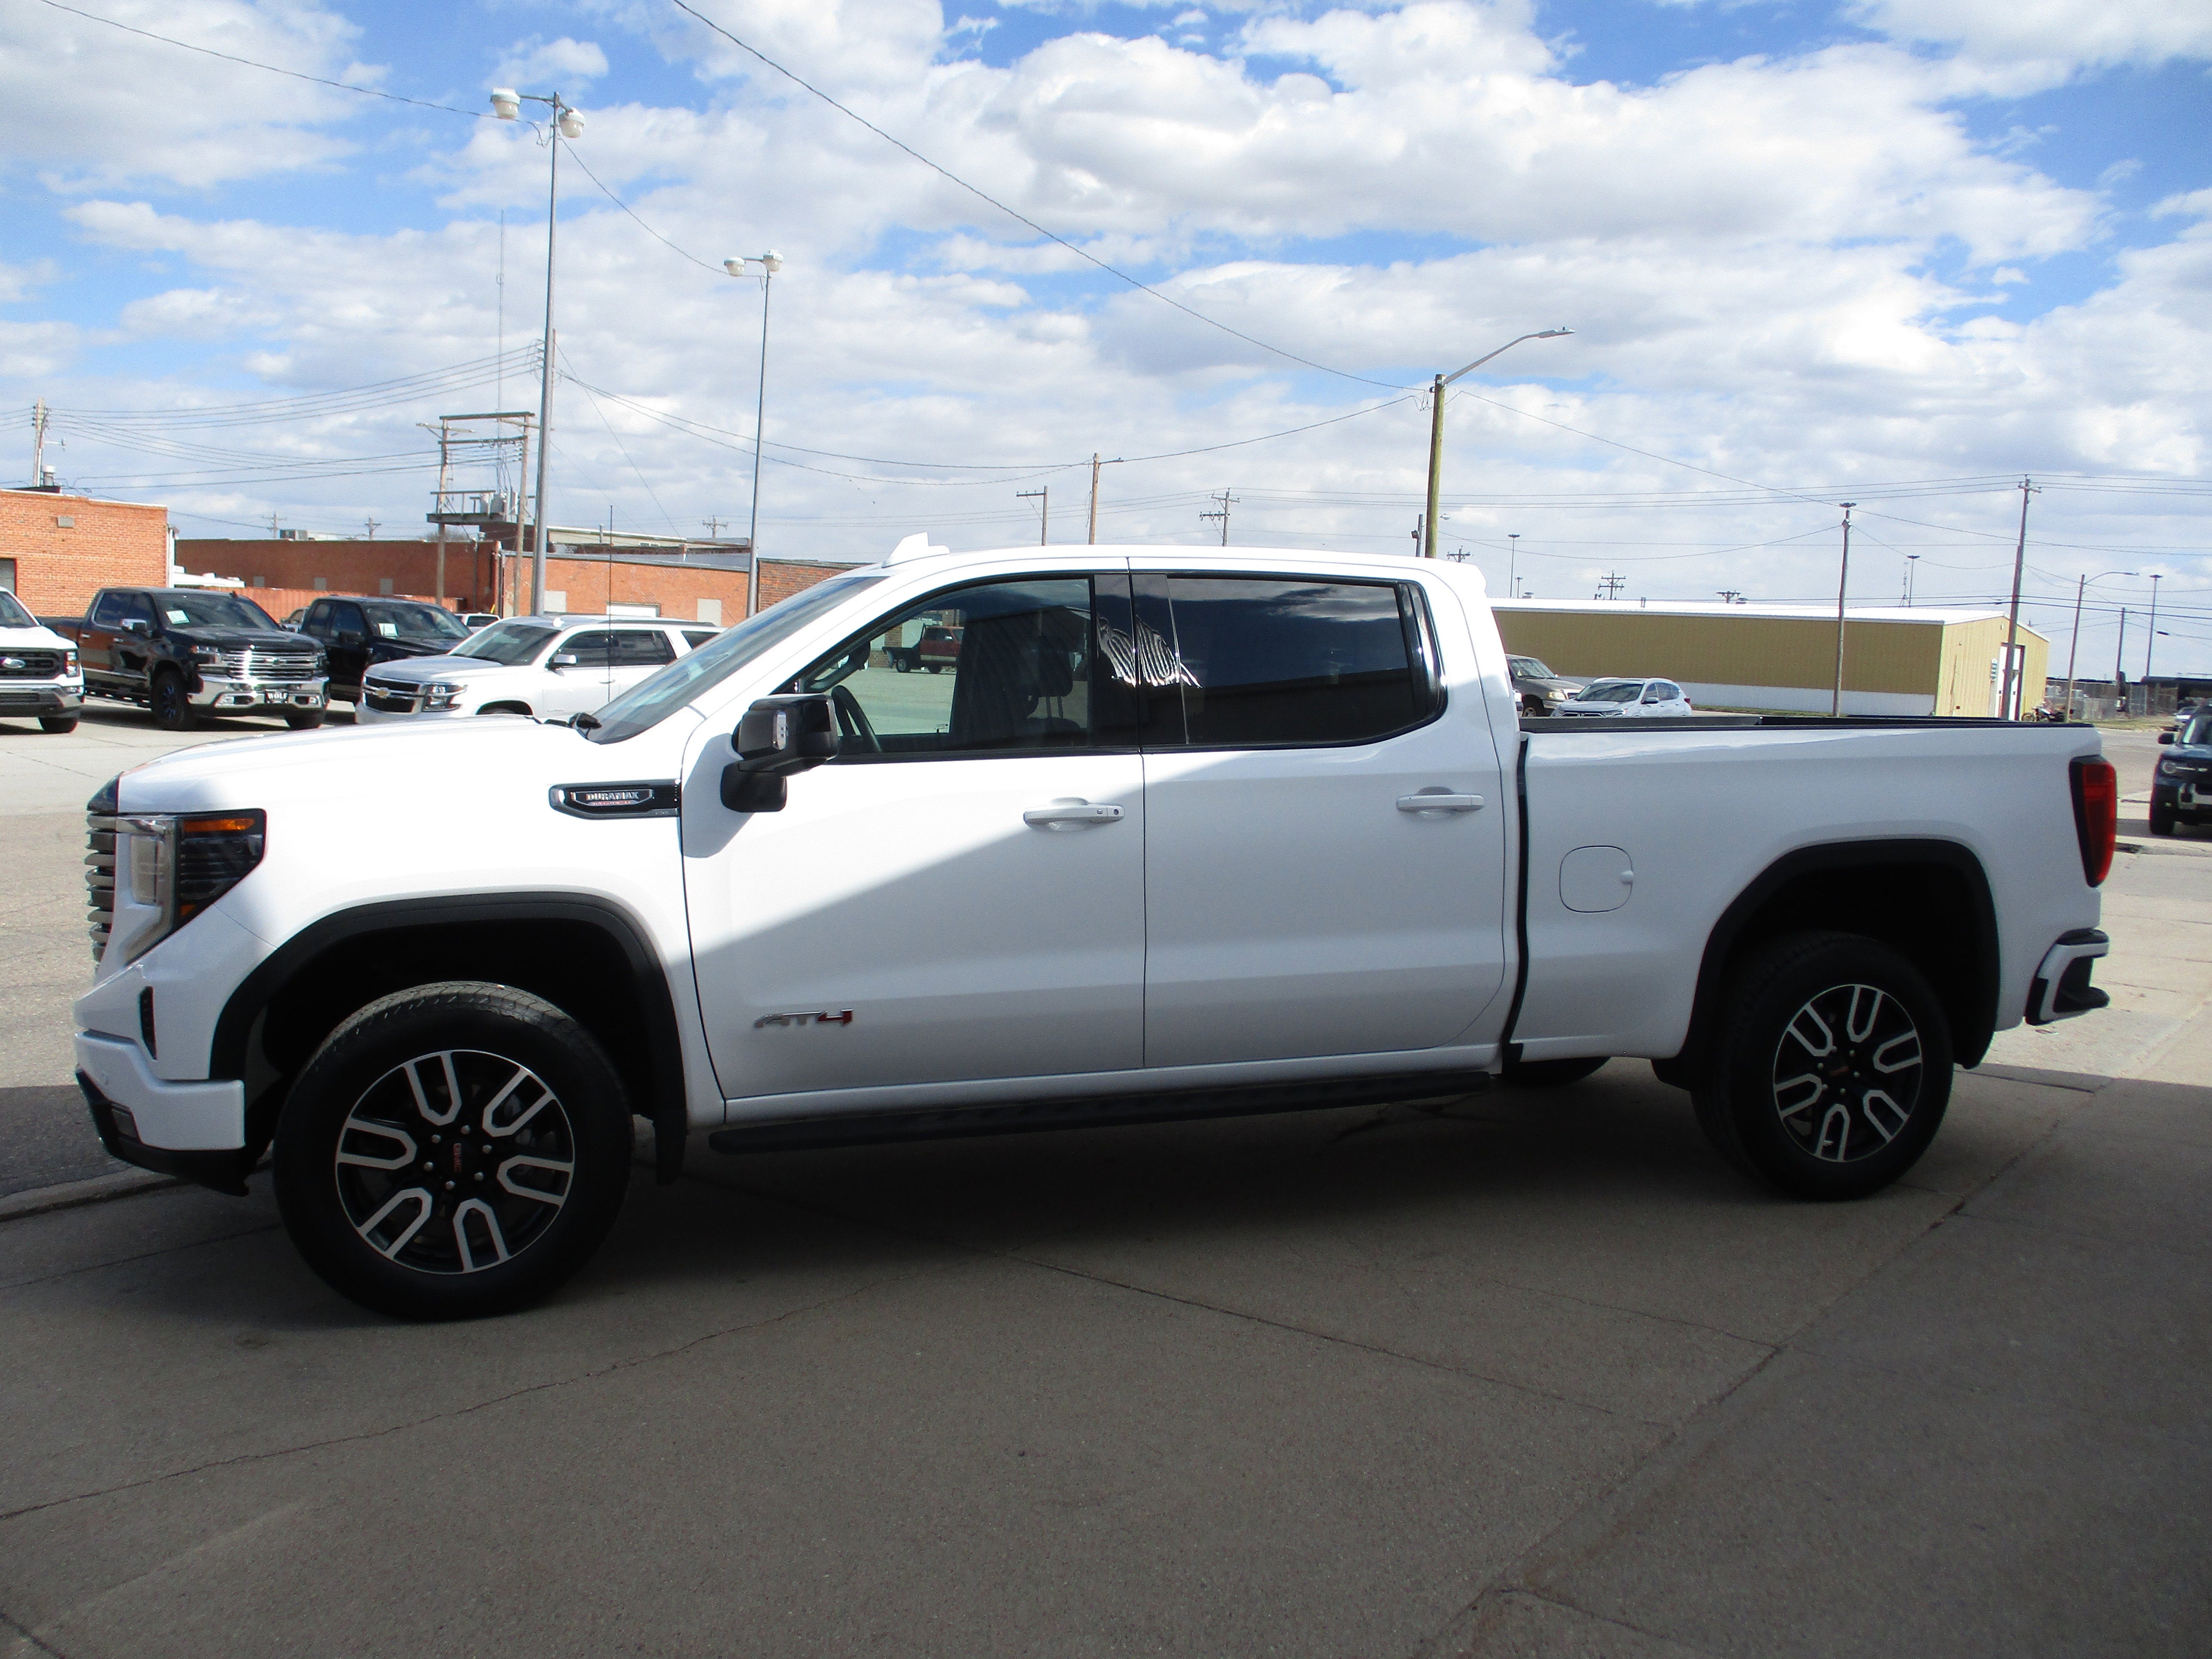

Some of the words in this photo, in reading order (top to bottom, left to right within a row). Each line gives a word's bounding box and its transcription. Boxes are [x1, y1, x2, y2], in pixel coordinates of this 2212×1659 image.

[585, 791, 639, 801] DURAMAX
[754, 1008, 853, 1028] AT4
[453, 1142, 463, 1173] GMC
